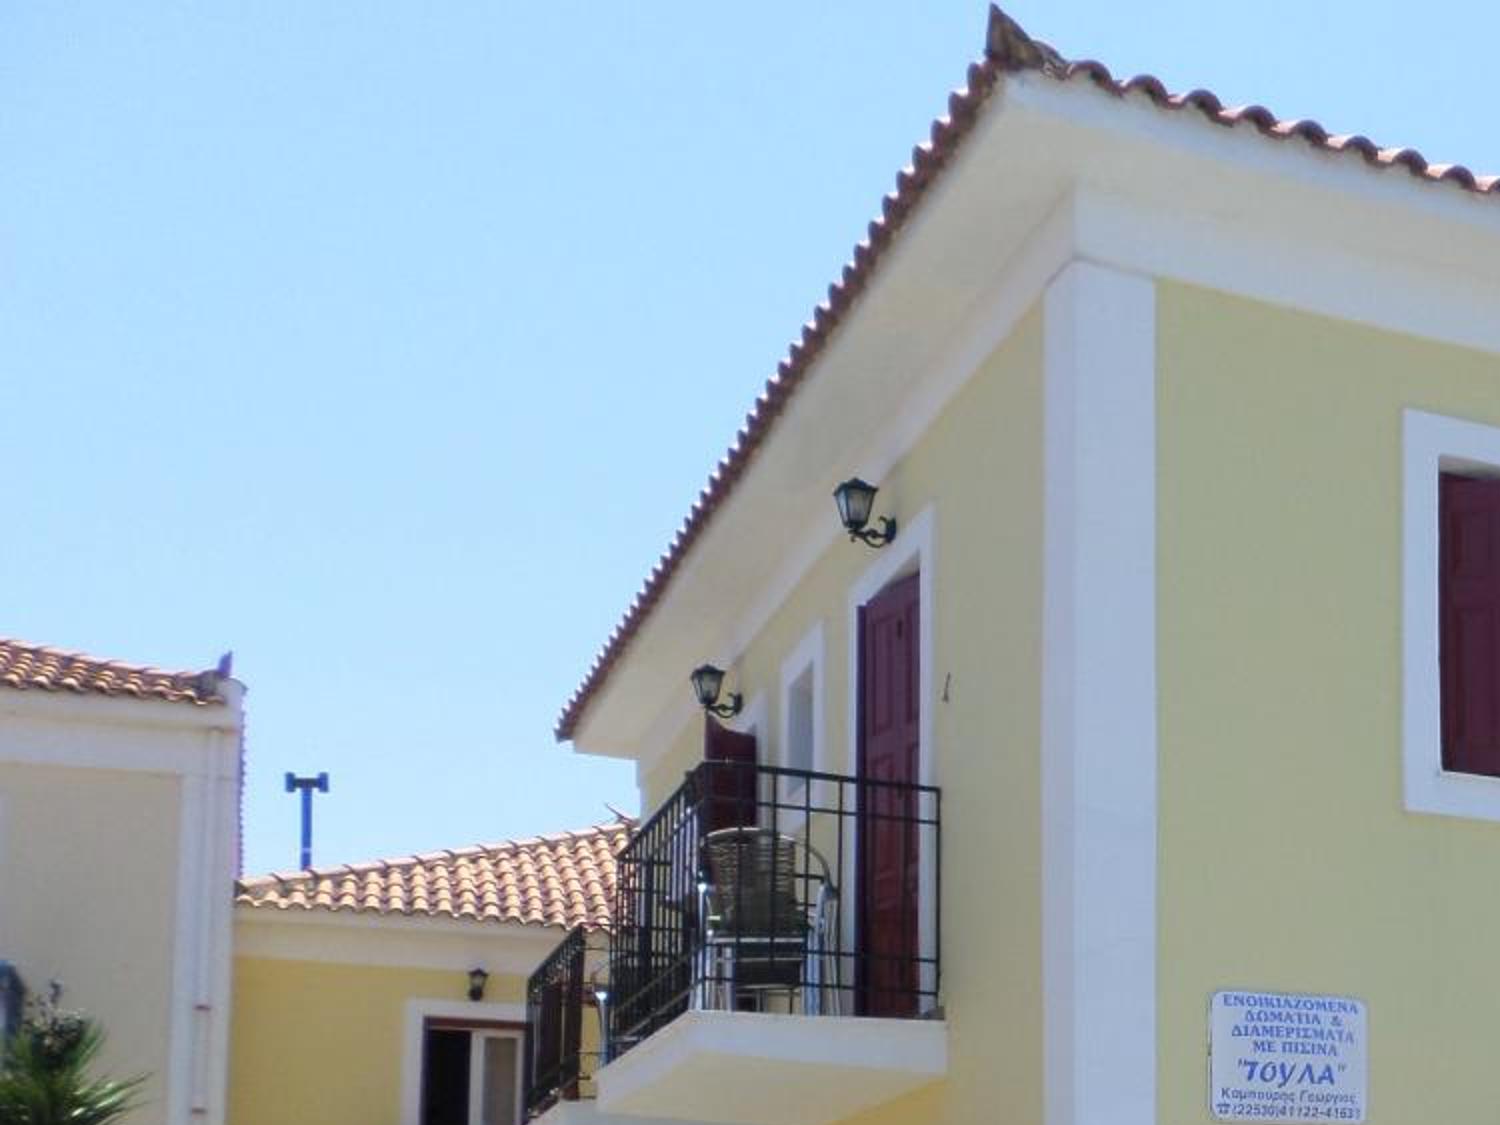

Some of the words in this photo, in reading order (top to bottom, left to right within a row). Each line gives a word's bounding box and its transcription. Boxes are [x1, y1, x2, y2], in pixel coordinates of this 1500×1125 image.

[1245, 1010, 1321, 1025] ΔΩΜΑΤΙΑ
[1330, 1015, 1343, 1027] &
[1231, 1025, 1355, 1045] ΔΙΑΜΕΡΙΣΜΑΤΑ
[1253, 1041, 1277, 1053] ΜΕ
[1282, 1041, 1338, 1057] ΠΙΣΙΝΑ
